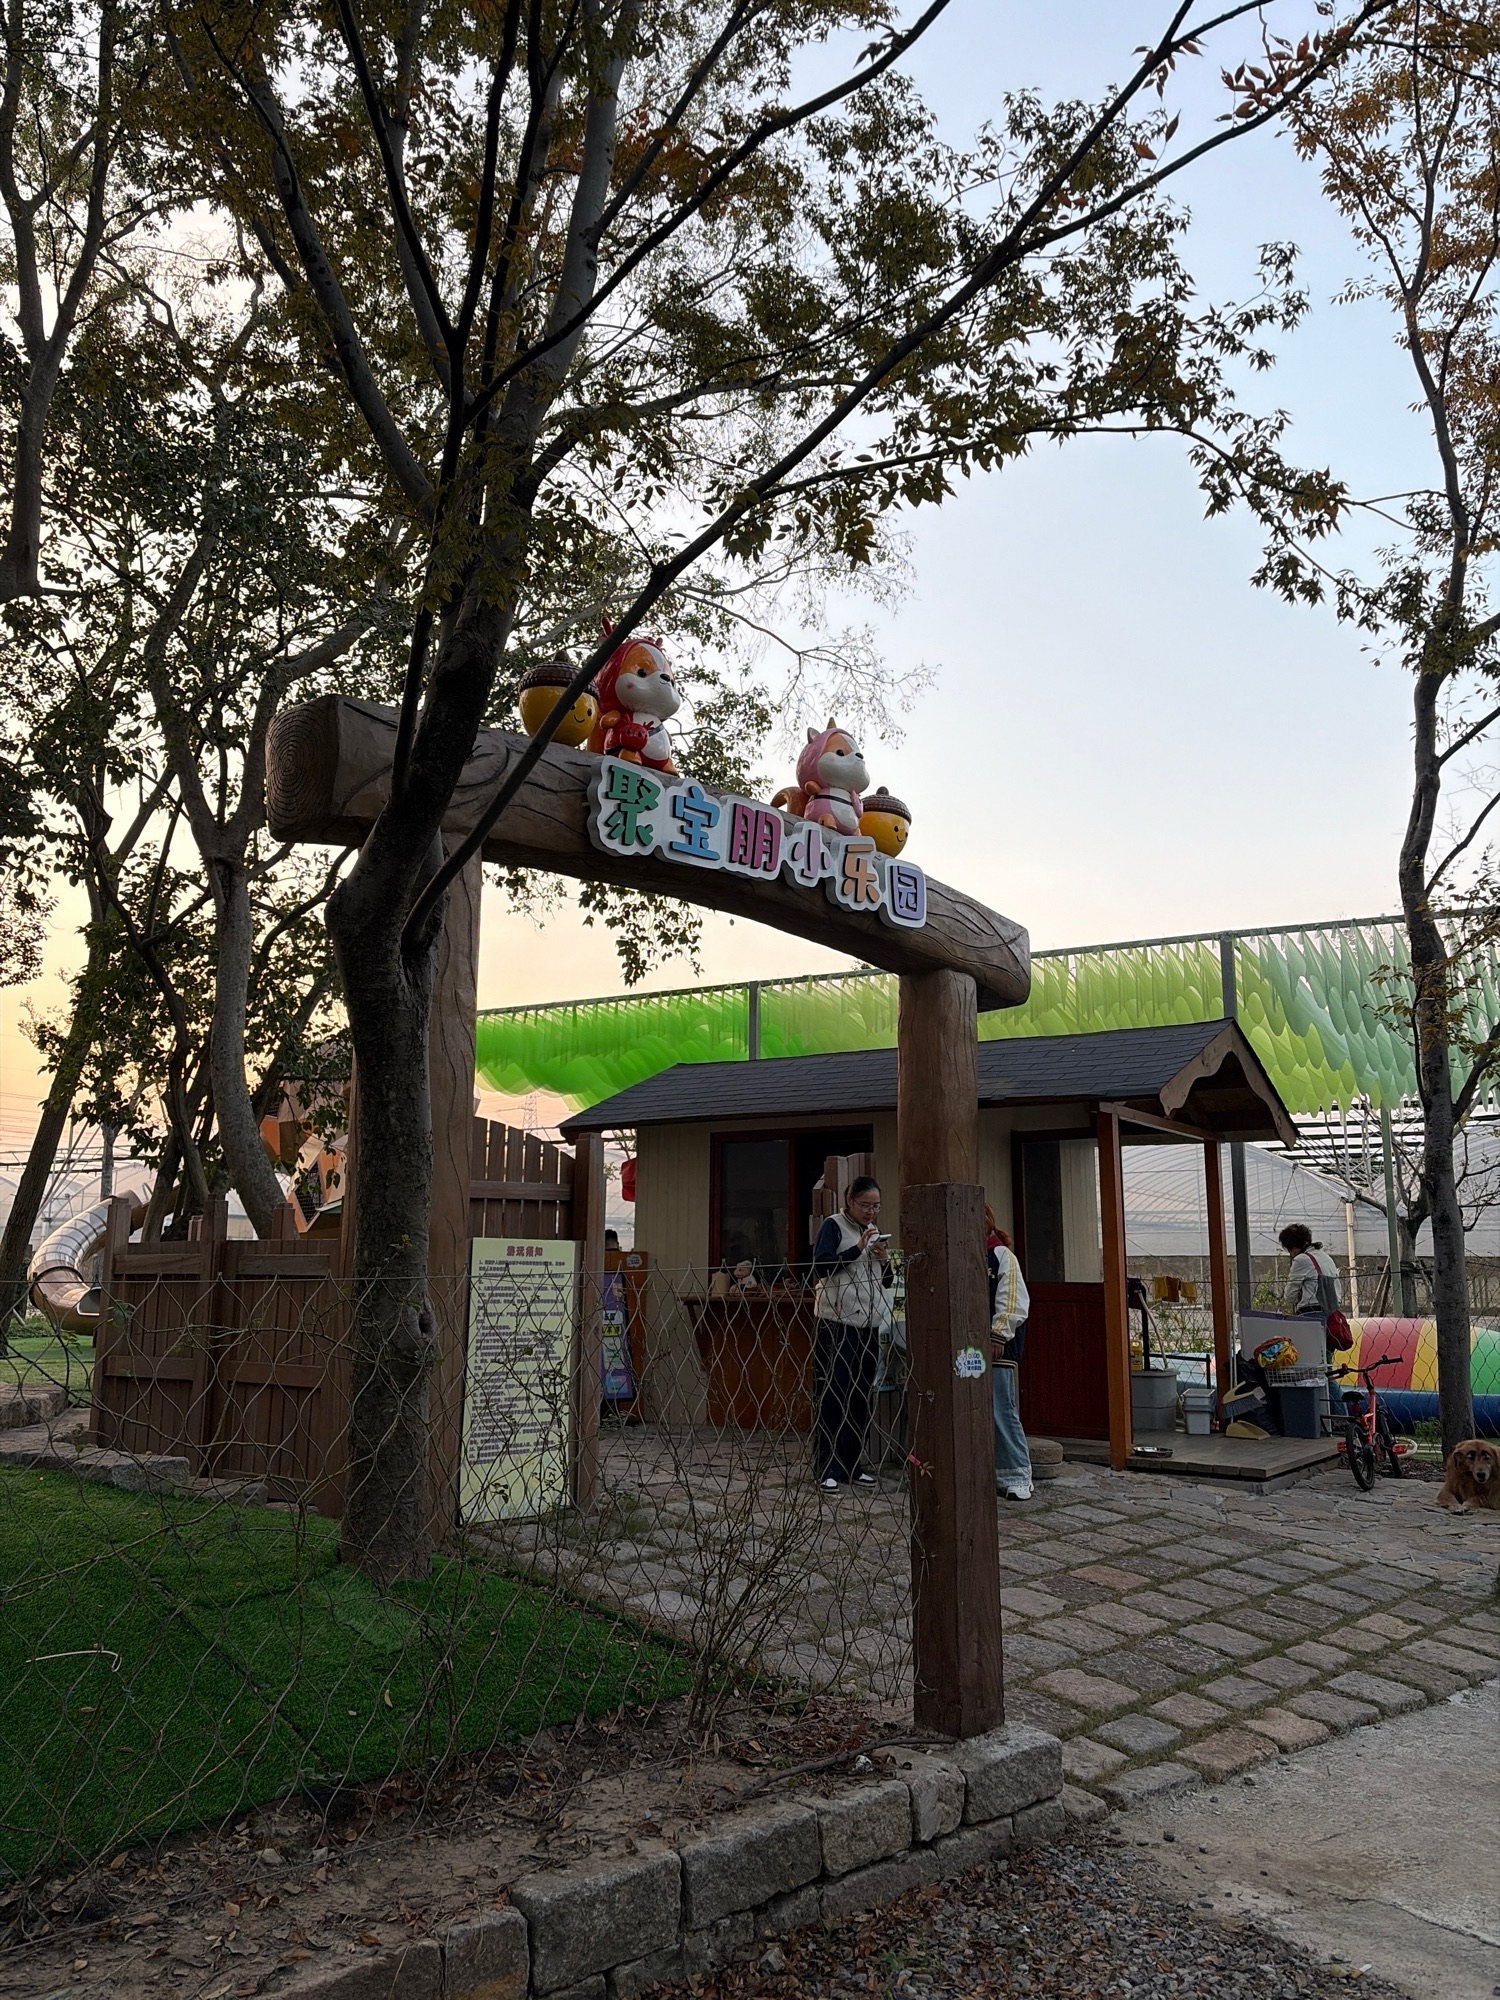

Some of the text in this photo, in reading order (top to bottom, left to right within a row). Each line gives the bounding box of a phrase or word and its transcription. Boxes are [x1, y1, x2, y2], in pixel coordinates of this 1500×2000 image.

[605, 764, 926, 920] 聚宝朋小乐园
